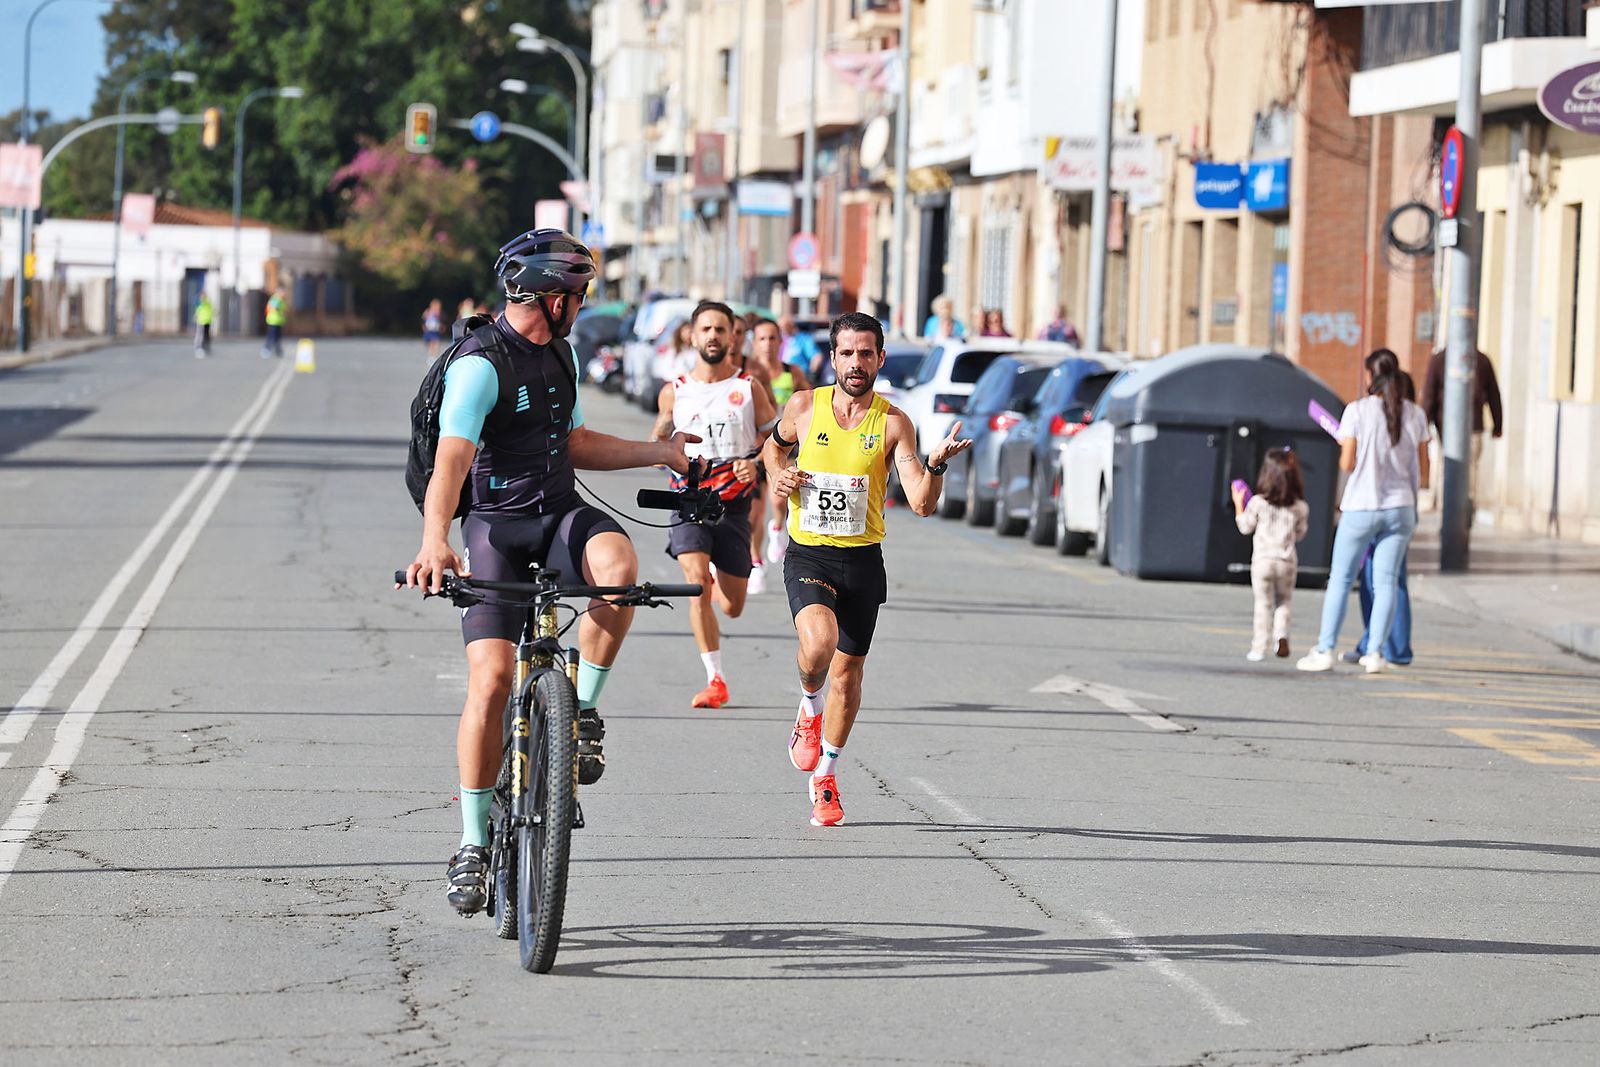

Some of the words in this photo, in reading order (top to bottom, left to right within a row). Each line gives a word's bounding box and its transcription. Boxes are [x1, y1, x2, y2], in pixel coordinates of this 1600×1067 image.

[706, 422, 725, 438] 17
[850, 477, 864, 488] 2K
[817, 490, 847, 511] 53
